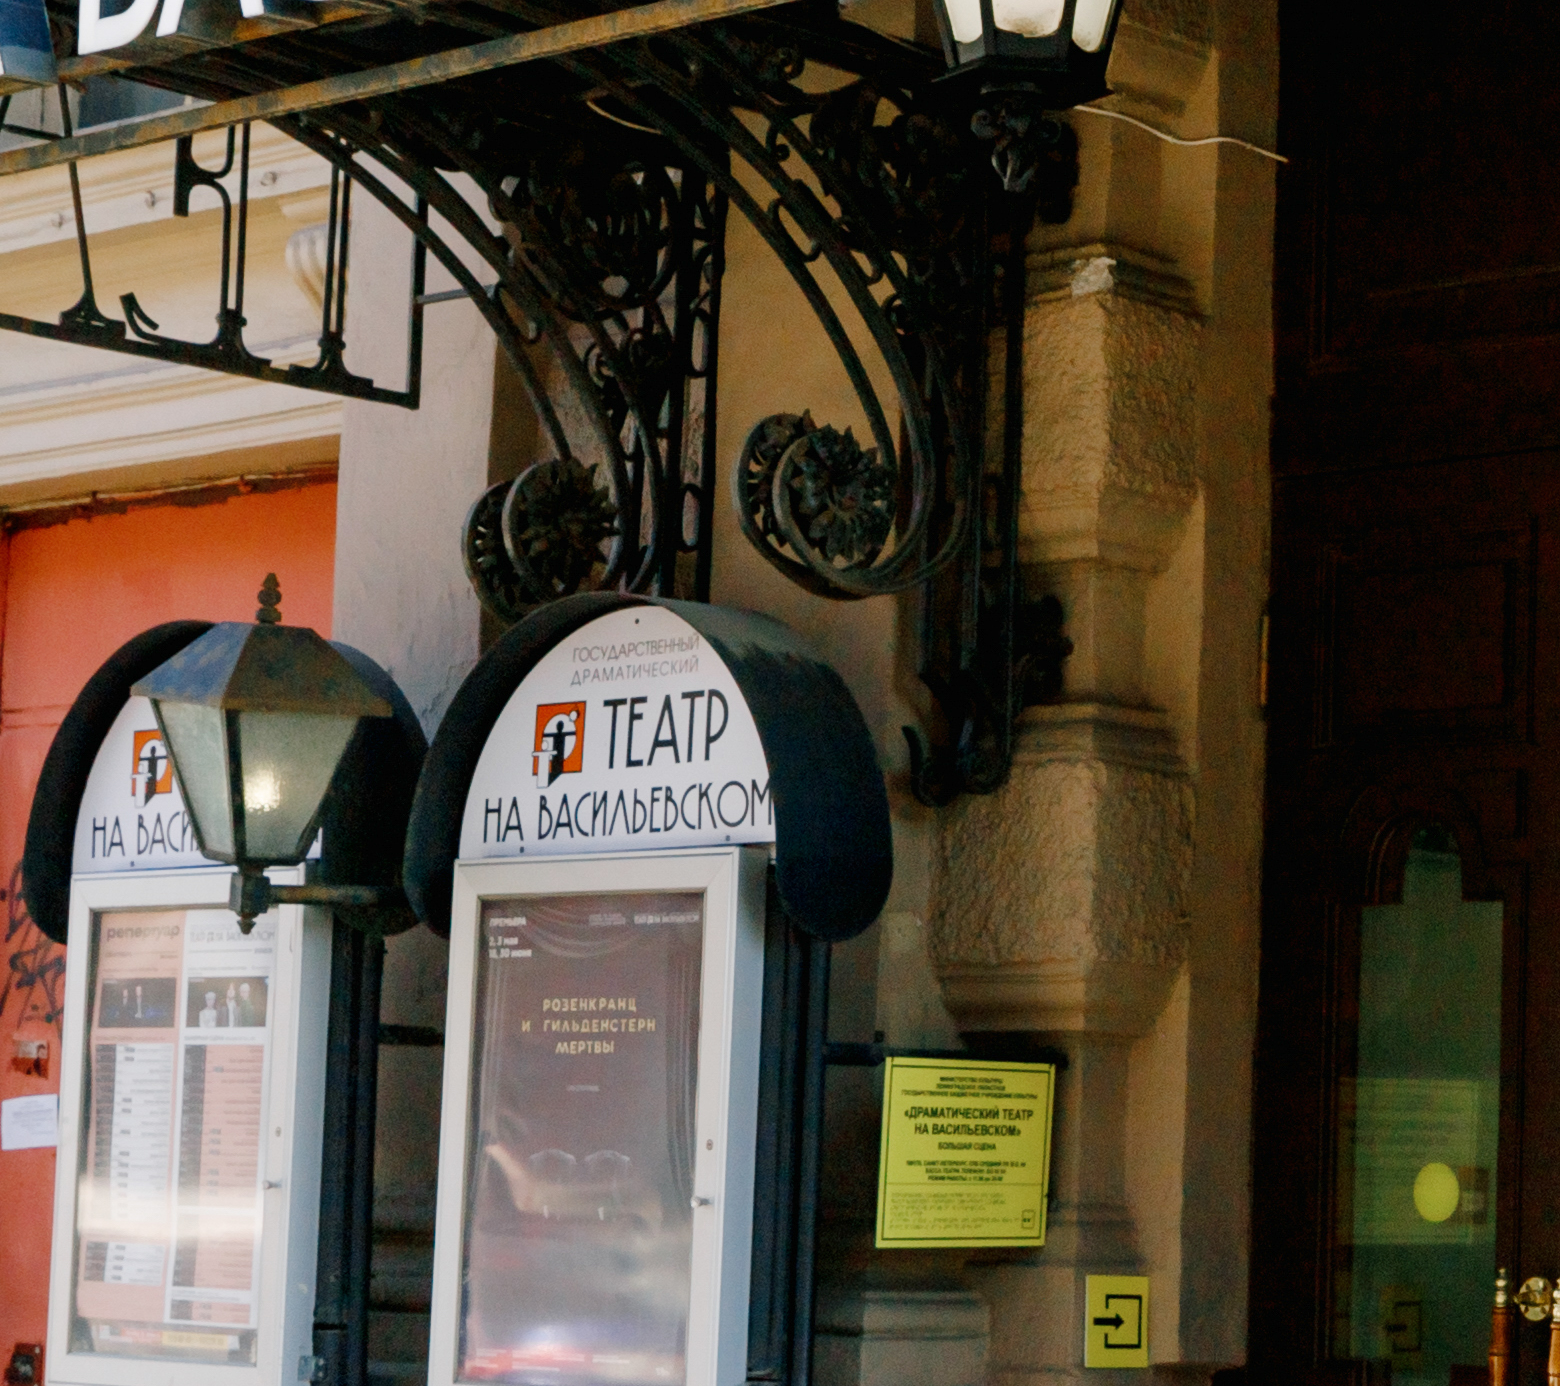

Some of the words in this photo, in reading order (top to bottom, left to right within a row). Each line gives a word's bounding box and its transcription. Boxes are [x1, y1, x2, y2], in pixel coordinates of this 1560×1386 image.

[572, 633, 700, 663] ГОСУДАРСТВЕННЫЙ
[570, 655, 700, 687] ДРАМАТИЧЕСКИЙ
[603, 689, 730, 770] ТЕАТР
[484, 796, 524, 844] НА
[538, 778, 774, 840] ВАСИЛЬЕВСКОМ
[91, 814, 127, 860] НА
[542, 997, 636, 1012] РОЗЕНКРАНЦ
[522, 1020, 530, 1032] И
[543, 1018, 656, 1032] ГИЛЬДЕНСТЕРН
[555, 1040, 614, 1055] МЕРТВЫ
[904, 1105, 1000, 1120] «ДРАМАТИЧЕСКИЙ
[1002, 1108, 1034, 1120] ТЕАТР
[914, 1123, 929, 1134] НА
[932, 1123, 1021, 1137] ВАСИЛЬЕВСКОМ»
